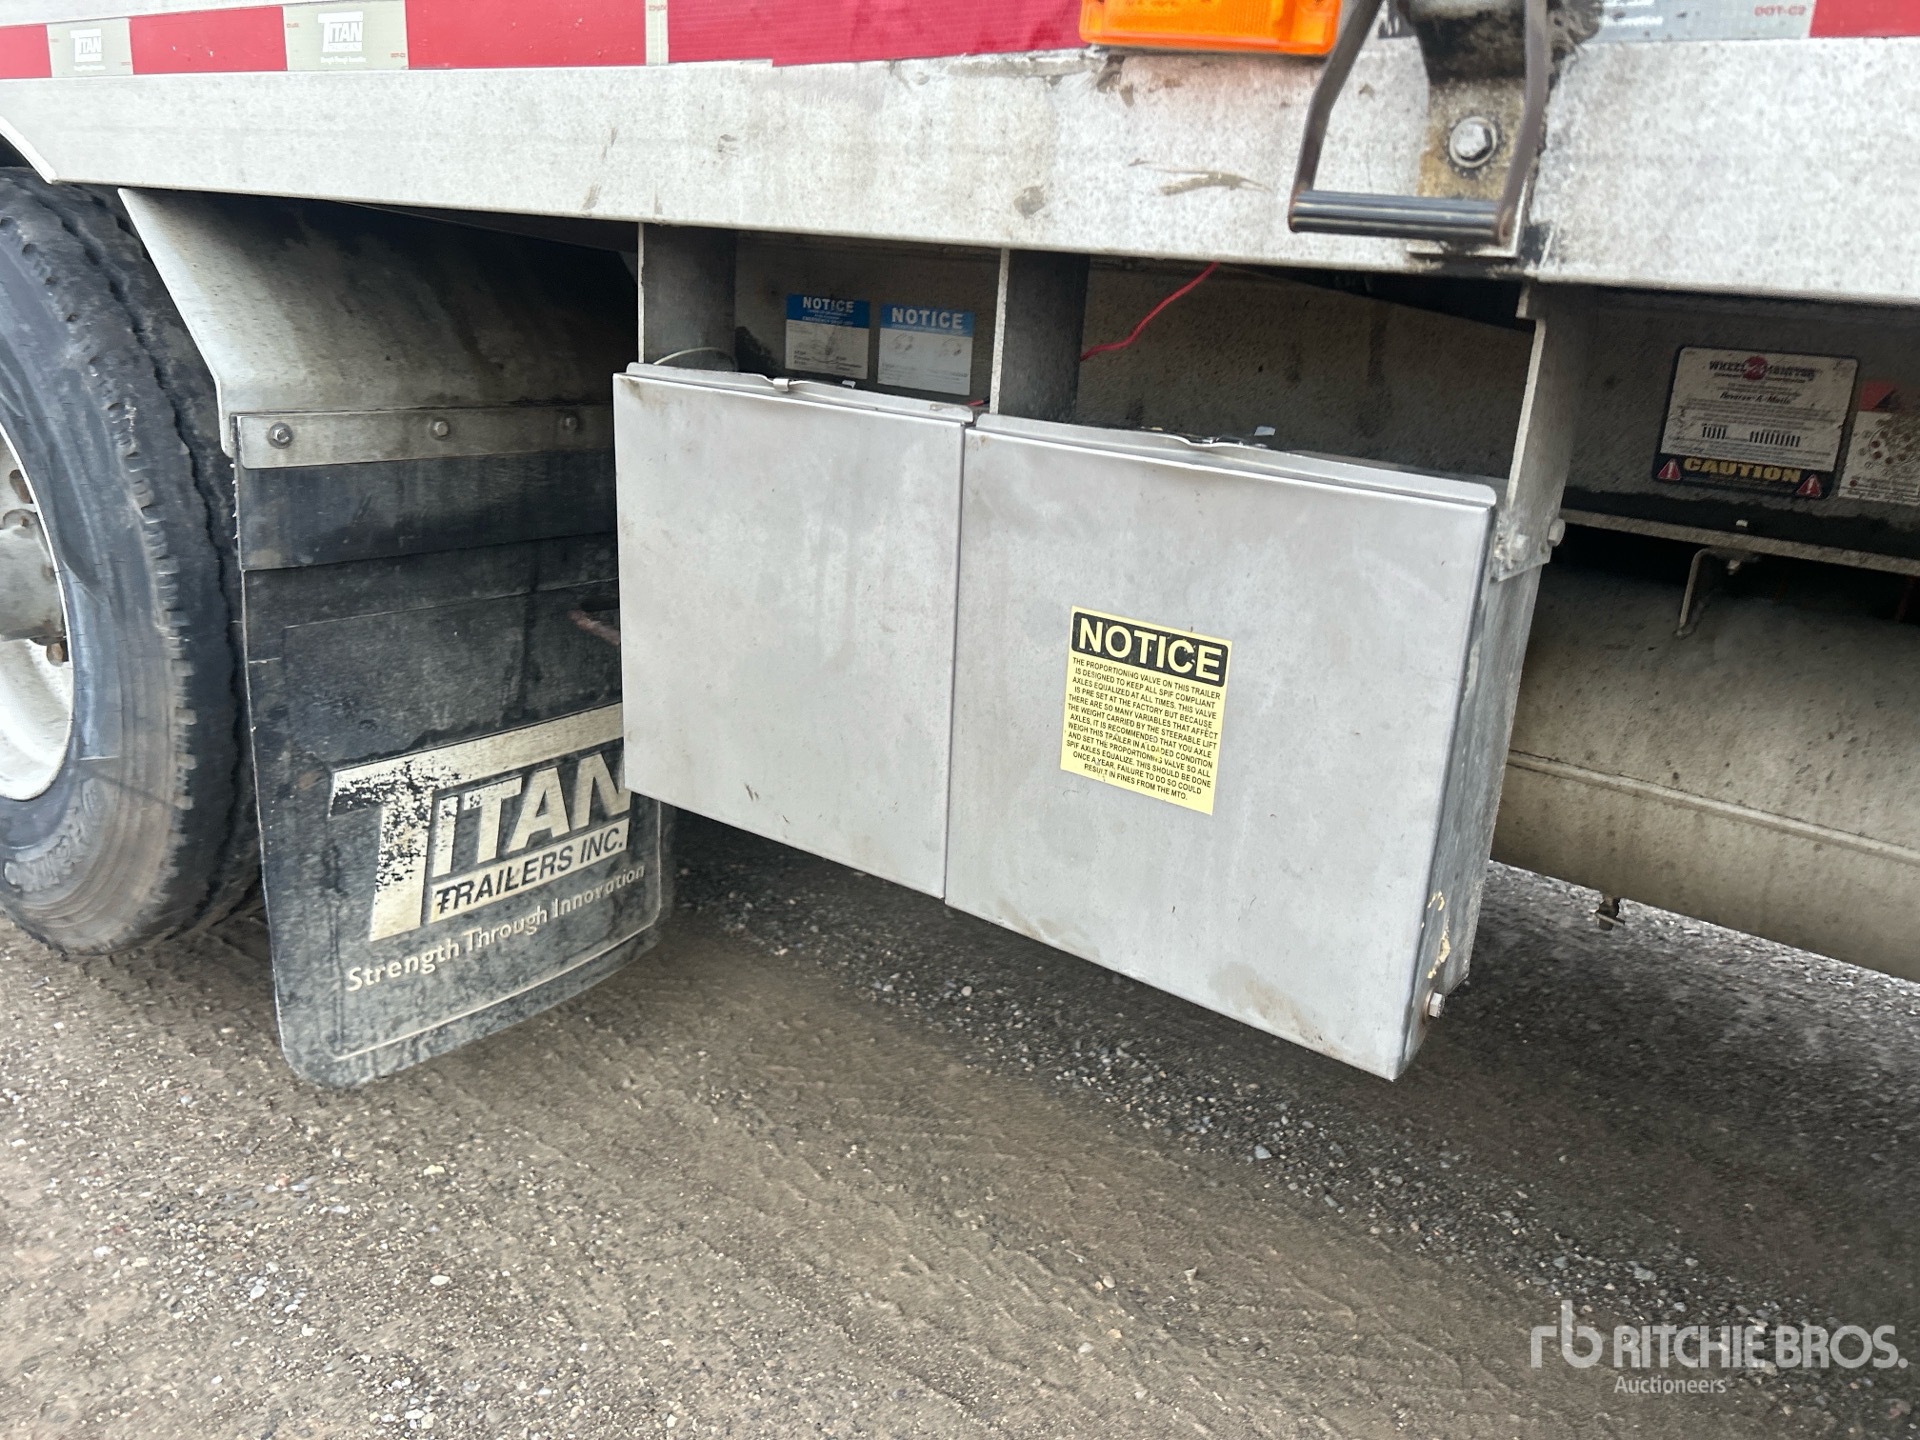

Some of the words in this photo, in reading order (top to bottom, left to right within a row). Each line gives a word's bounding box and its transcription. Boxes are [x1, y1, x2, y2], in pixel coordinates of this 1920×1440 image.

[802, 296, 854, 313] NOTICE
[892, 307, 963, 329] NOTICE
[1683, 458, 1801, 483] CAUTION
[1078, 617, 1222, 682] NOTICE
[1072, 656, 1084, 666] THE
[1085, 660, 1139, 680] PROPORTIONING
[1140, 673, 1161, 685] VALVE
[1173, 682, 1190, 693] THIS
[1190, 686, 1220, 700] TRAILER
[1072, 675, 1092, 687] AXLES
[1093, 681, 1130, 697] EQUALIZED
[1140, 693, 1153, 703] ALL
[1177, 703, 1193, 714] THIS
[1194, 707, 1217, 720] VALVE
[1082, 669, 1114, 683] DESIGNED
[1126, 679, 1144, 691] KEEP
[1144, 684, 1157, 694] ALL
[1158, 688, 1174, 698] SPIF
[1174, 692, 1215, 709] COMPLIANT
[1067, 702, 1079, 712] THE
[1080, 706, 1105, 719] WEIGHT
[1105, 713, 1135, 727] CARRIED
[1146, 724, 1159, 734] THE
[1160, 728, 1201, 745] STEERABLE
[1202, 739, 1217, 750] LIFT
[1068, 693, 1089, 706] THERE
[1089, 699, 1103, 709] ARE
[1114, 705, 1133, 717] MANY
[1133, 711, 1171, 727] VARIABLES
[1172, 721, 1190, 733] THAT
[1190, 726, 1218, 740] AFFECT
[1081, 687, 1094, 697] PRE
[1095, 691, 1108, 701] SET
[1118, 697, 1131, 707] THE
[1132, 701, 1163, 716] FACTORY
[1164, 709, 1178, 719] BUT
[1179, 713, 1213, 729] BECAUSE
[1067, 721, 1088, 733] WEIGH
[1089, 727, 1103, 738] THIS
[1104, 731, 1132, 746] TRAILER
[1146, 743, 1174, 758] LOADED
[1174, 751, 1213, 769] CONDITION
[1068, 730, 1081, 741] AND
[1082, 734, 1094, 744] SET
[1095, 738, 1108, 748] THE
[1109, 742, 1163, 764] PROPORTIONING
[1163, 758, 1185, 770] VALVE
[1197, 767, 1210, 778] ALL
[1107, 723, 1158, 744] RECOMMENDED
[1159, 737, 1177, 749] THAT
[1177, 742, 1192, 753] YOU
[1193, 746, 1212, 758] AXLE
[1066, 739, 1079, 749] SPIF
[1080, 743, 1100, 756] AXLES
[1135, 759, 1151, 770] THIS
[1151, 764, 1180, 779] SHOULD
[1191, 775, 1211, 788] DONE
[1072, 750, 1091, 762] ONCE
[1116, 763, 1144, 778] FAILURE
[1177, 781, 1201, 795] COULD
[1116, 772, 1135, 784] FINES
[1136, 778, 1155, 790] FROM
[1156, 784, 1170, 795] THE
[1170, 788, 1188, 800] MTO.
[328, 702, 630, 941] TITAN
[436, 847, 573, 913] TRAILERS
[580, 828, 624, 866] INC.
[348, 939, 460, 991] Strength
[464, 906, 547, 952] Through
[552, 864, 644, 919] Innovation
